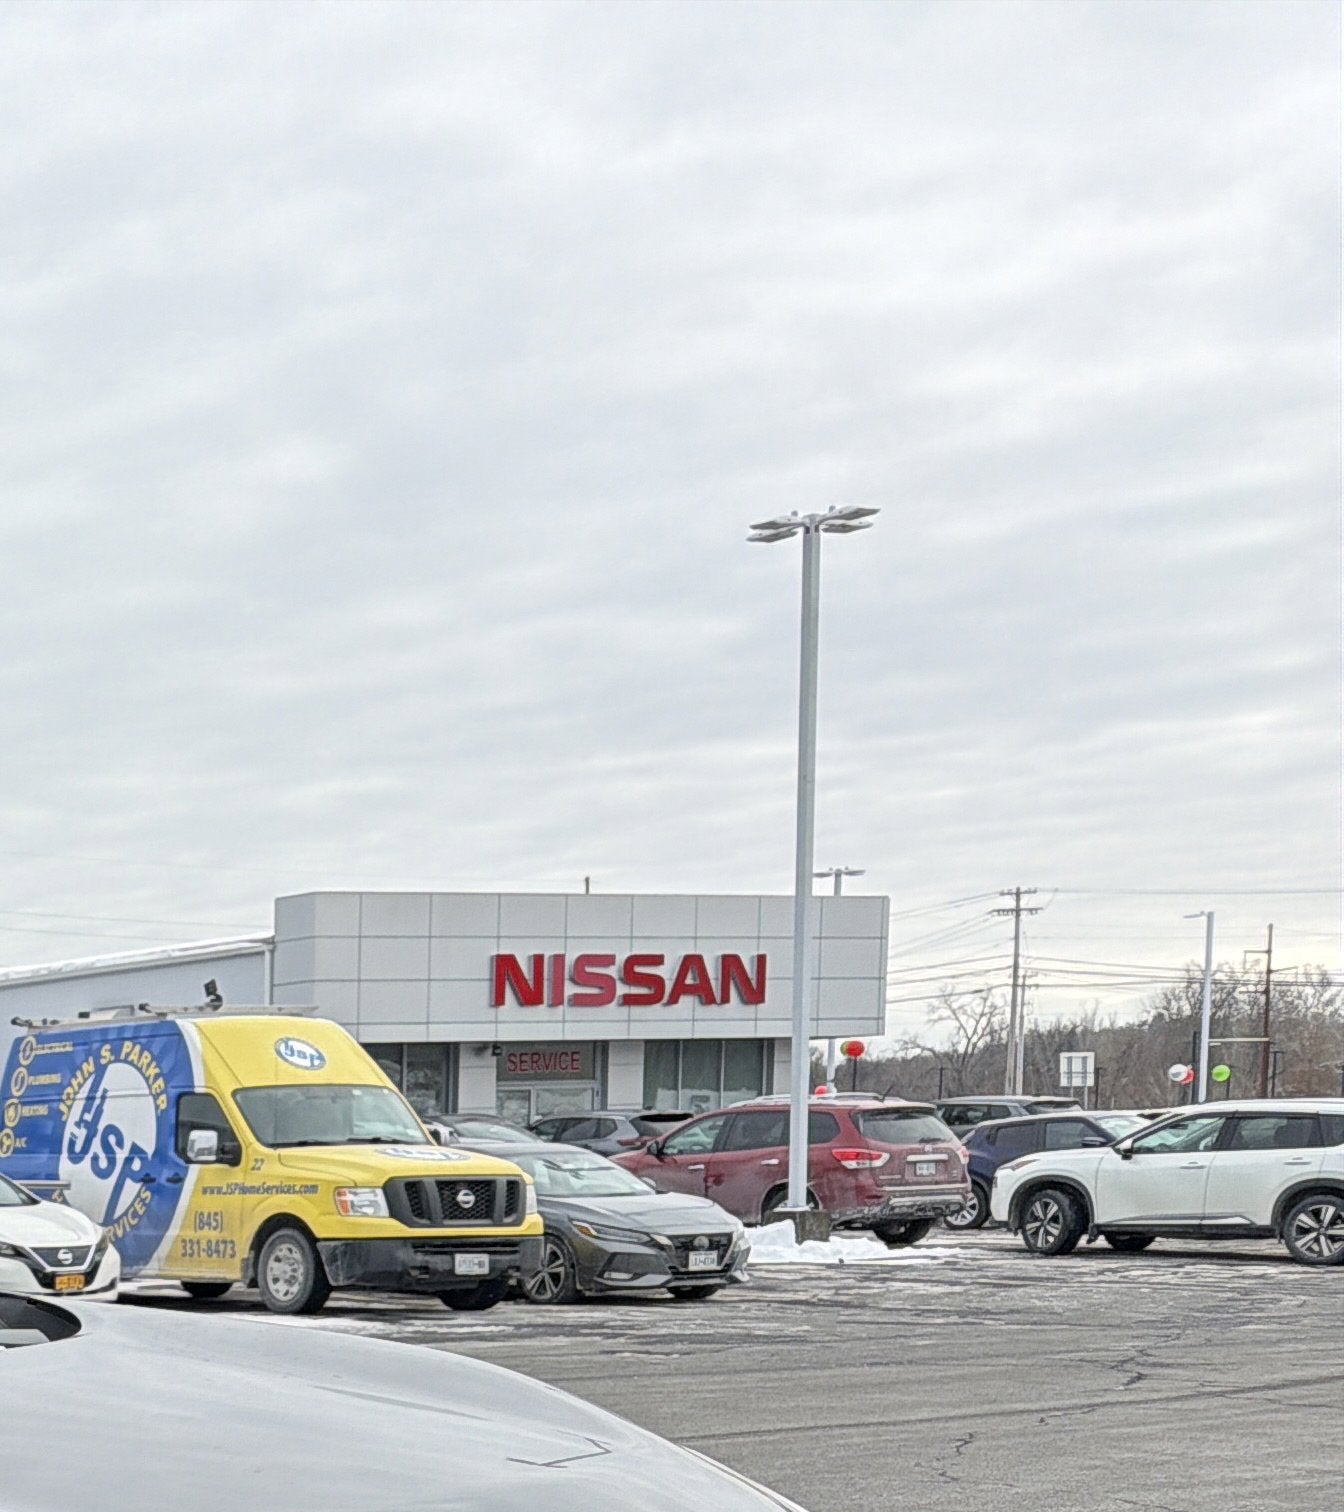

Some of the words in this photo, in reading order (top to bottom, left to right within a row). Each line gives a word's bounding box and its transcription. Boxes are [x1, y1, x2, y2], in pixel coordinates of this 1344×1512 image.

[491, 953, 767, 1007] NISSAN
[507, 1051, 580, 1073] SERVICE
[59, 1056, 95, 1121] JOHN
[100, 1043, 115, 1065] S.
[120, 1041, 168, 1110] PARKER
[250, 1158, 265, 1171] 22
[202, 1182, 319, 1195] www.JSPHomeServices.com
[105, 1186, 152, 1242] RVICES
[194, 1211, 223, 1233] (845)
[180, 1239, 237, 1259] 331-8473
